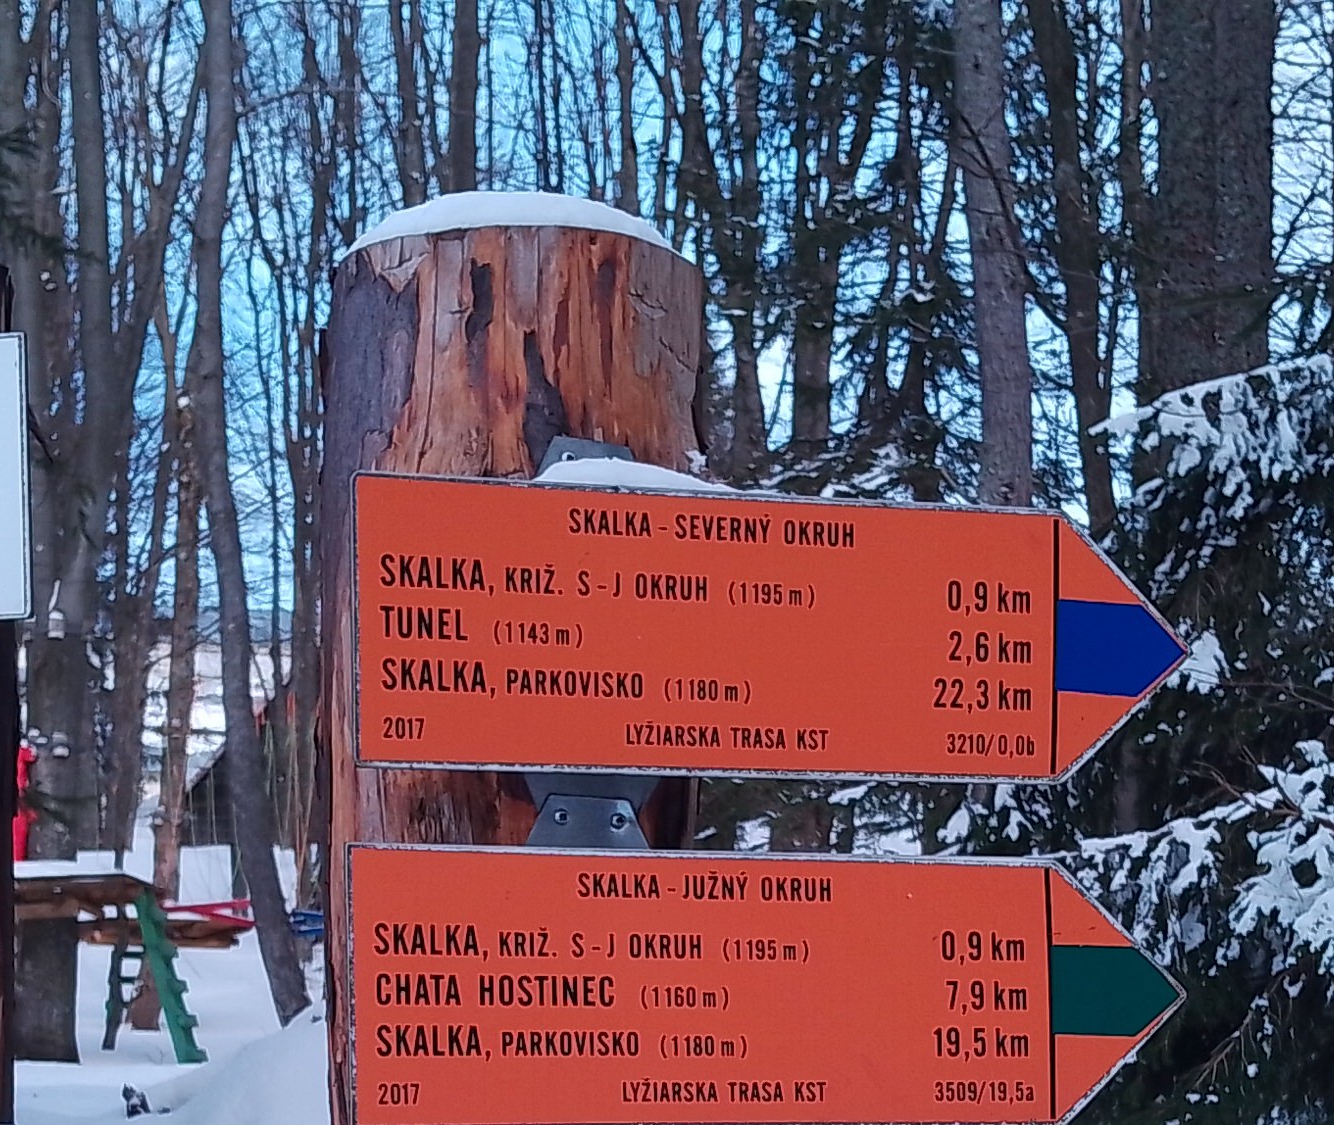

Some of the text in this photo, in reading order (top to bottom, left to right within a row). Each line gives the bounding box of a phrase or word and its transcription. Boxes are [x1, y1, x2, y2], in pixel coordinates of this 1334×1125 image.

[568, 507, 652, 538] SKALKA
[674, 513, 772, 544] SEVERNÝ
[784, 519, 855, 548] OKRUH
[380, 553, 494, 597] SKALKA,
[505, 563, 563, 596] KRIŽ.
[635, 573, 708, 602] OKRUH
[947, 580, 988, 617] 0,9
[997, 582, 1031, 614] km
[379, 605, 469, 641] TUNEL
[948, 630, 990, 667] 2,6
[998, 632, 1032, 664] km
[381, 657, 496, 699] SKALKA,
[506, 668, 643, 699] PARKOVISKO
[933, 677, 990, 714] 22,3
[998, 679, 1032, 711] km
[382, 716, 425, 740] 2017
[626, 720, 829, 751] LYŽIARSKA TRASA KST
[577, 872, 661, 899] SKALKA
[682, 870, 748, 901] JUŽNÝ
[760, 876, 832, 902] OKRUH
[373, 922, 488, 962] SKALKA,
[498, 927, 557, 958] KRIŽ.
[629, 933, 702, 960] OKRUH
[941, 930, 982, 966] 0,9
[991, 931, 1025, 962] km
[376, 973, 462, 1006] CHATA
[479, 974, 615, 1008] HOSTINEC
[945, 980, 985, 1016] 7,9
[993, 980, 1028, 1011] km
[376, 1024, 491, 1062] SKALKA,
[501, 1030, 639, 1057] PARKOVISKO
[933, 1026, 987, 1062] 19,5
[995, 1027, 1029, 1058] km
[378, 1082, 420, 1106] 2017
[622, 1077, 827, 1103] LYŽIARSKA TRASA KST
[934, 1081, 1035, 1105] 3509/19,5a
